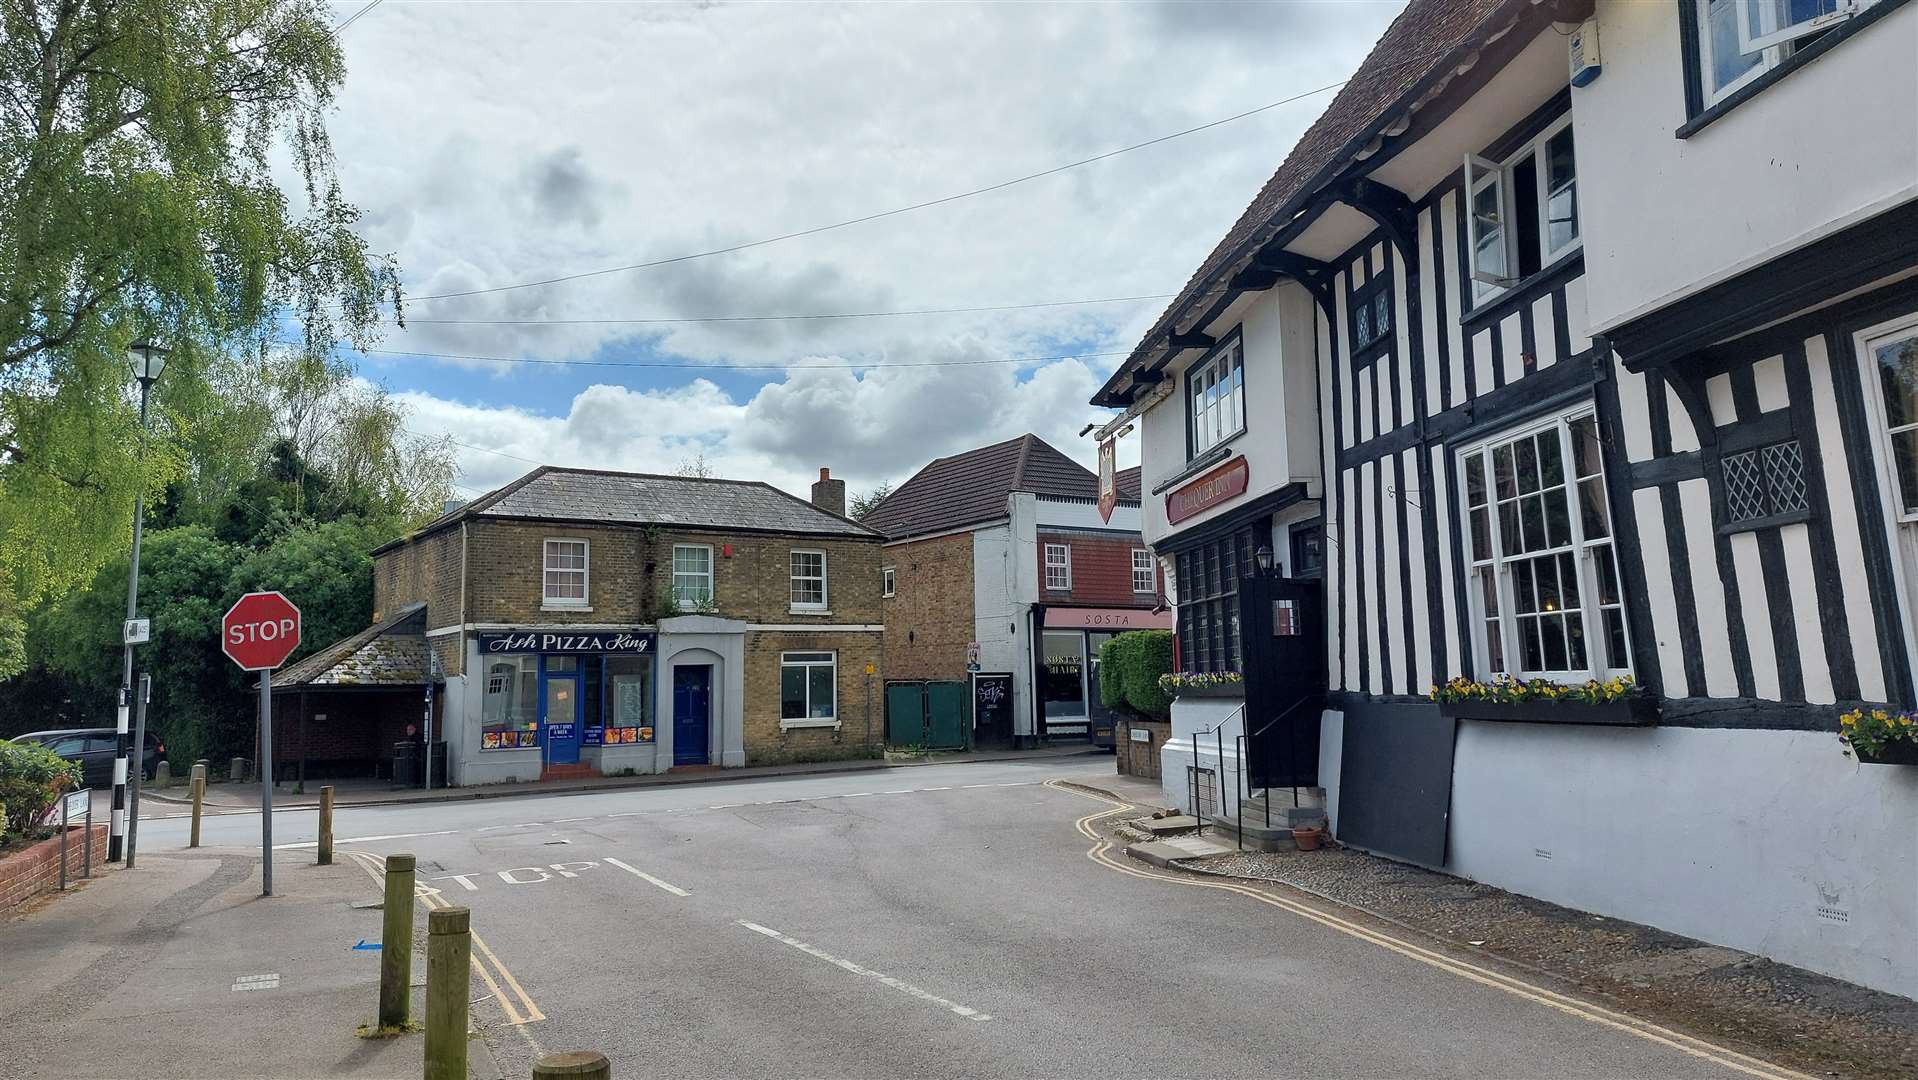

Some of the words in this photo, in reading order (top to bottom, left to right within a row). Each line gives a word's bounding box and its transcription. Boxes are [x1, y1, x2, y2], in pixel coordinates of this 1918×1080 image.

[229, 618, 295, 645] STOP
[489, 633, 537, 652] Ash
[542, 634, 603, 650] PIZZA
[605, 633, 648, 653] King
